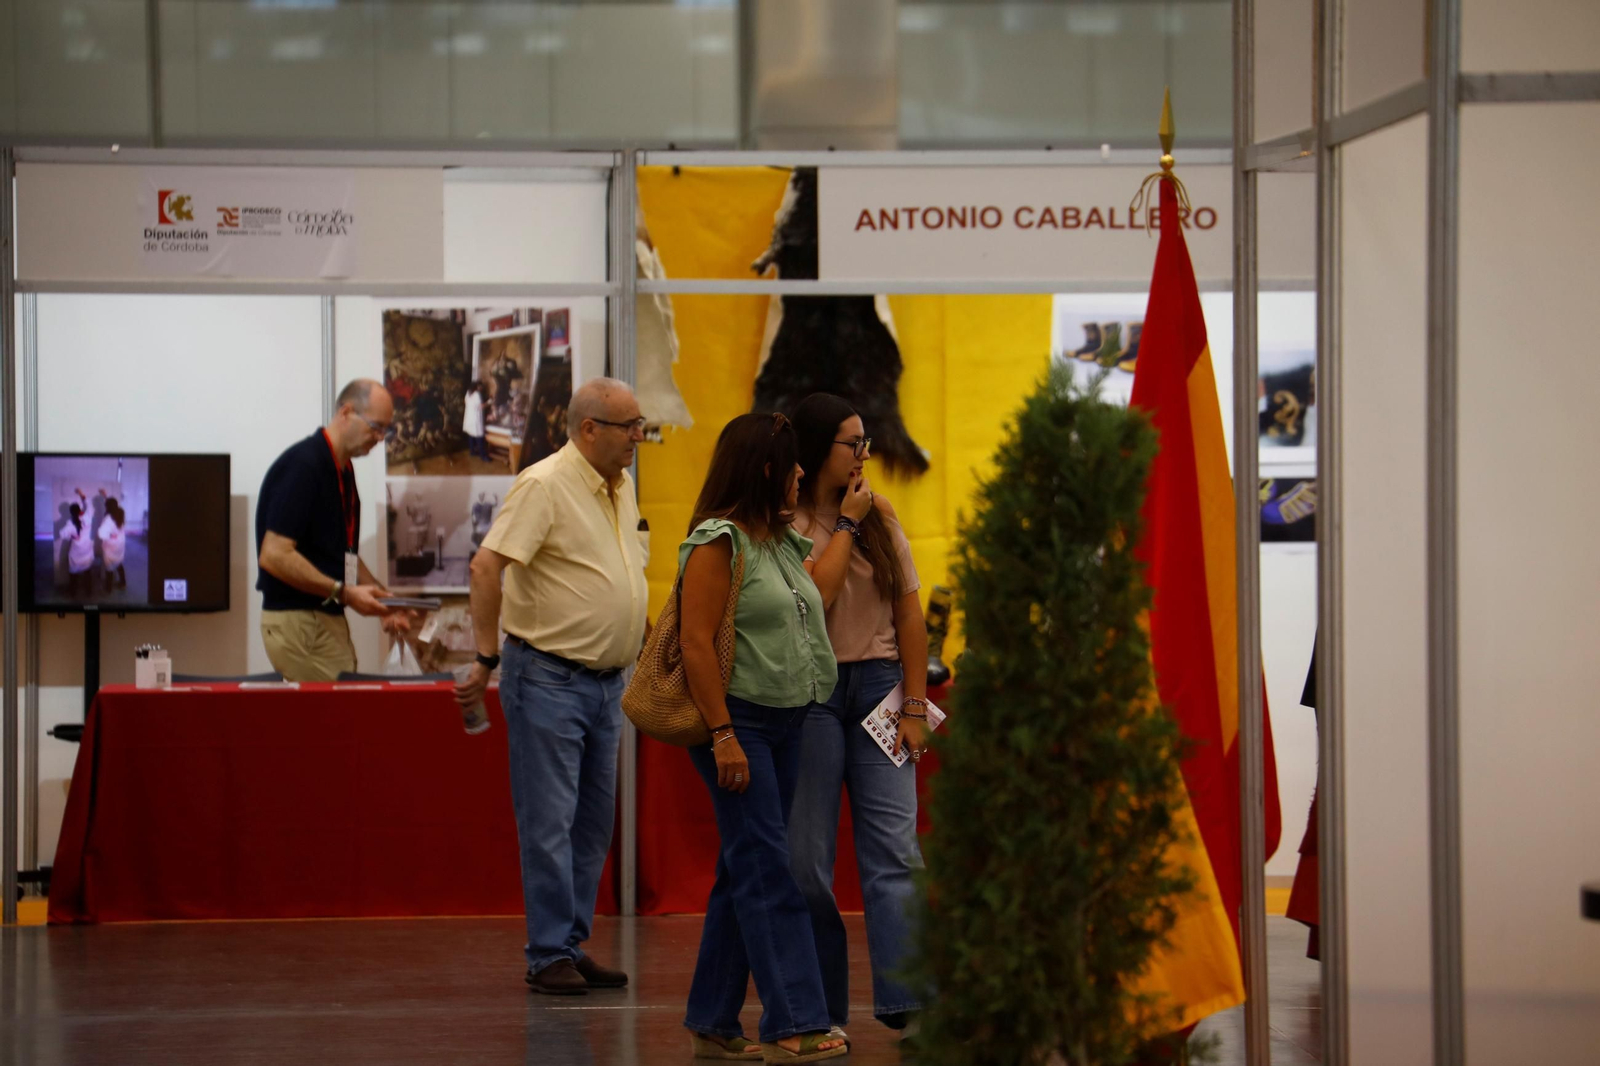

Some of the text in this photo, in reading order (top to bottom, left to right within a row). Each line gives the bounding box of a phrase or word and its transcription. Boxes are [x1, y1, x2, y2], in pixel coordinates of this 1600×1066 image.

[854, 205, 1003, 231] ANTONIO
[143, 227, 208, 241] Diputación
[143, 241, 209, 252] de Córdoba
[866, 719, 903, 762] CRDOBA
